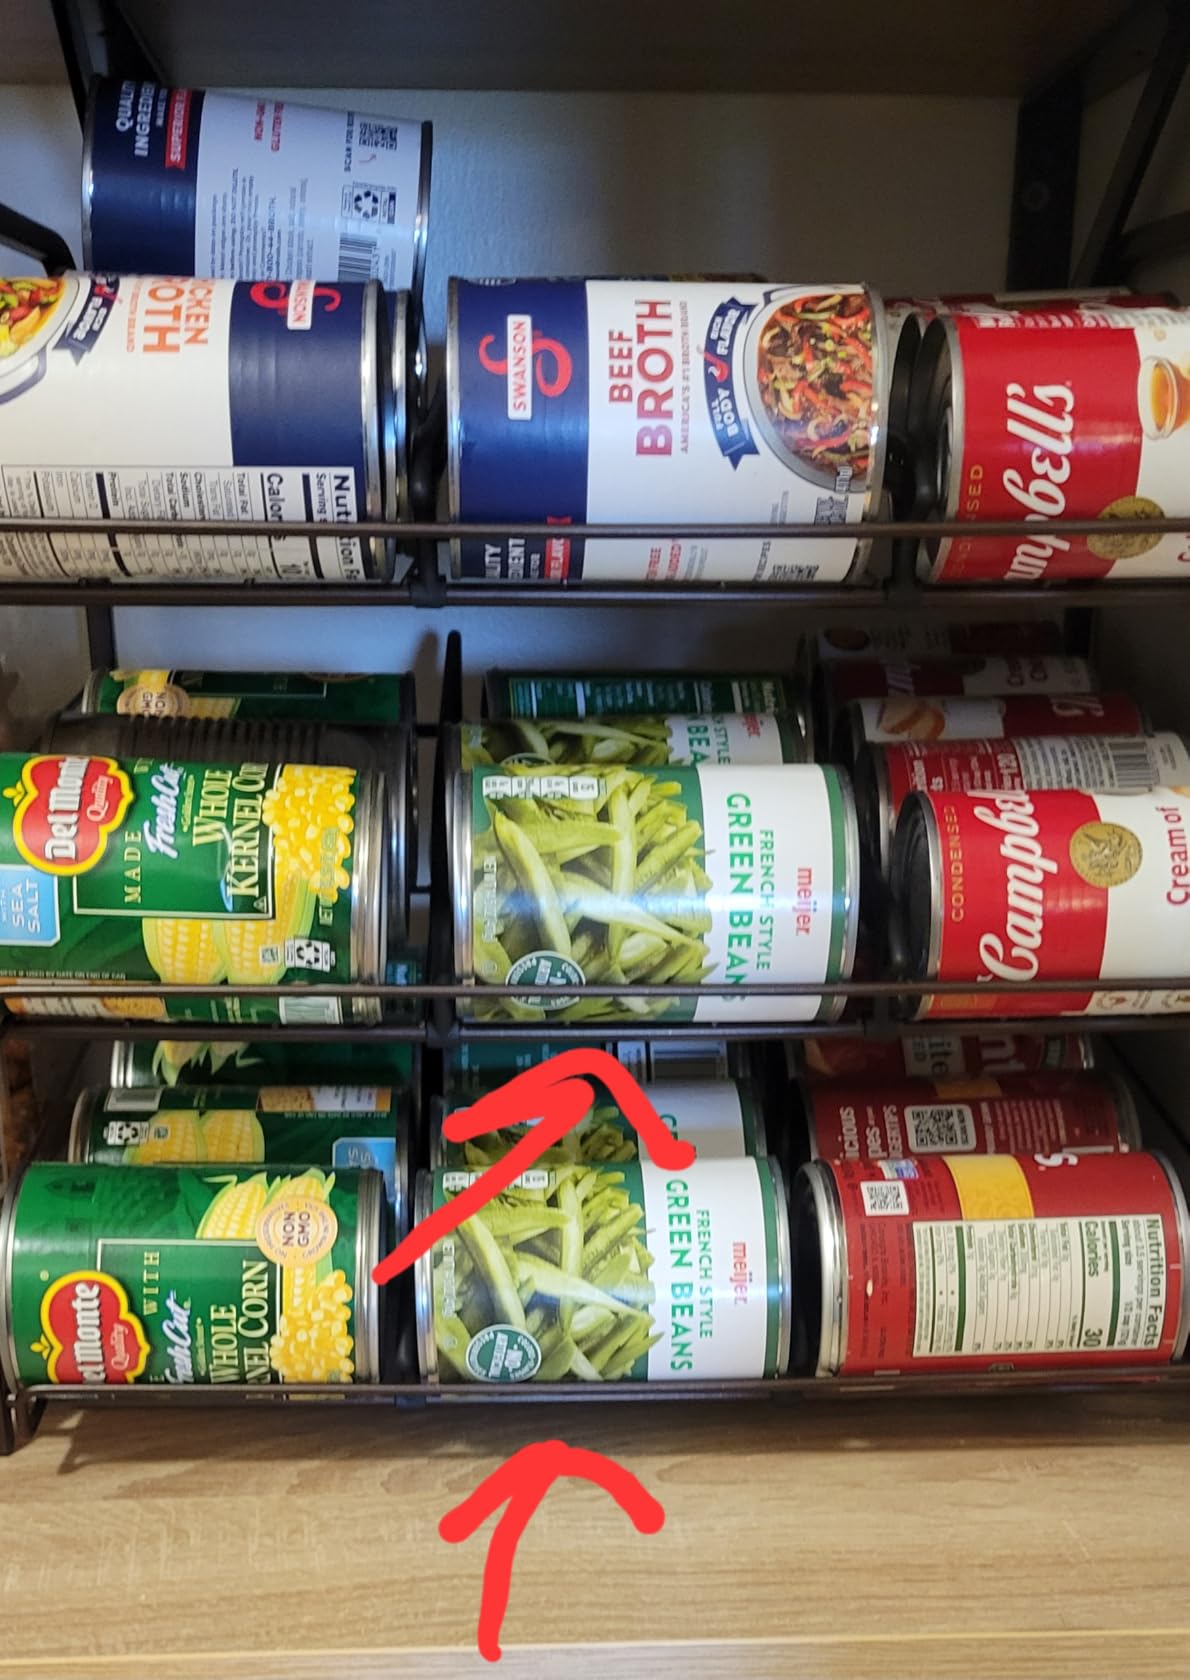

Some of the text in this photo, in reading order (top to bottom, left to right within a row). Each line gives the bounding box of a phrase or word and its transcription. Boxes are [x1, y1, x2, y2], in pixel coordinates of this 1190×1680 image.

[183, 279, 215, 345] ICKEN
[513, 320, 528, 412] SWANSON
[607, 330, 634, 404] BEEF
[634, 298, 675, 457] BROTH
[678, 385, 692, 455] AMERICA'S
[717, 387, 740, 437] BODY
[44, 811, 79, 860] Del
[143, 796, 179, 859] Fresh
[192, 768, 233, 847] WHOLE
[124, 830, 142, 904] MADE
[225, 792, 263, 898] KERNEL
[726, 793, 755, 896] GREEN
[1154, 806, 1190, 906] Cream of
[11, 882, 25, 927] SEA
[25, 877, 42, 933] SALT
[756, 828, 775, 971] FRENCH STYLE
[792, 867, 818, 937] meijer
[281, 1210, 298, 1247] NON
[297, 1209, 312, 1248] GMO
[665, 1179, 694, 1268] GREEN
[1084, 1220, 1103, 1278] Calories
[1121, 1219, 1132, 1248] Serving
[143, 1250, 161, 1316] WITH
[237, 1259, 271, 1338] CORN
[696, 1209, 713, 1340] FRENCH STYLE
[730, 1241, 753, 1306] meijer
[1135, 1260, 1145, 1295] servings
[1144, 1218, 1165, 1346] Nutrition Facts
[72, 1282, 103, 1360] Monte
[110, 1322, 132, 1370] Quality
[161, 1300, 192, 1348] Cut
[209, 1303, 241, 1383] WHOLE
[670, 1281, 695, 1371] BEANS
[1082, 1327, 1104, 1348] 30
